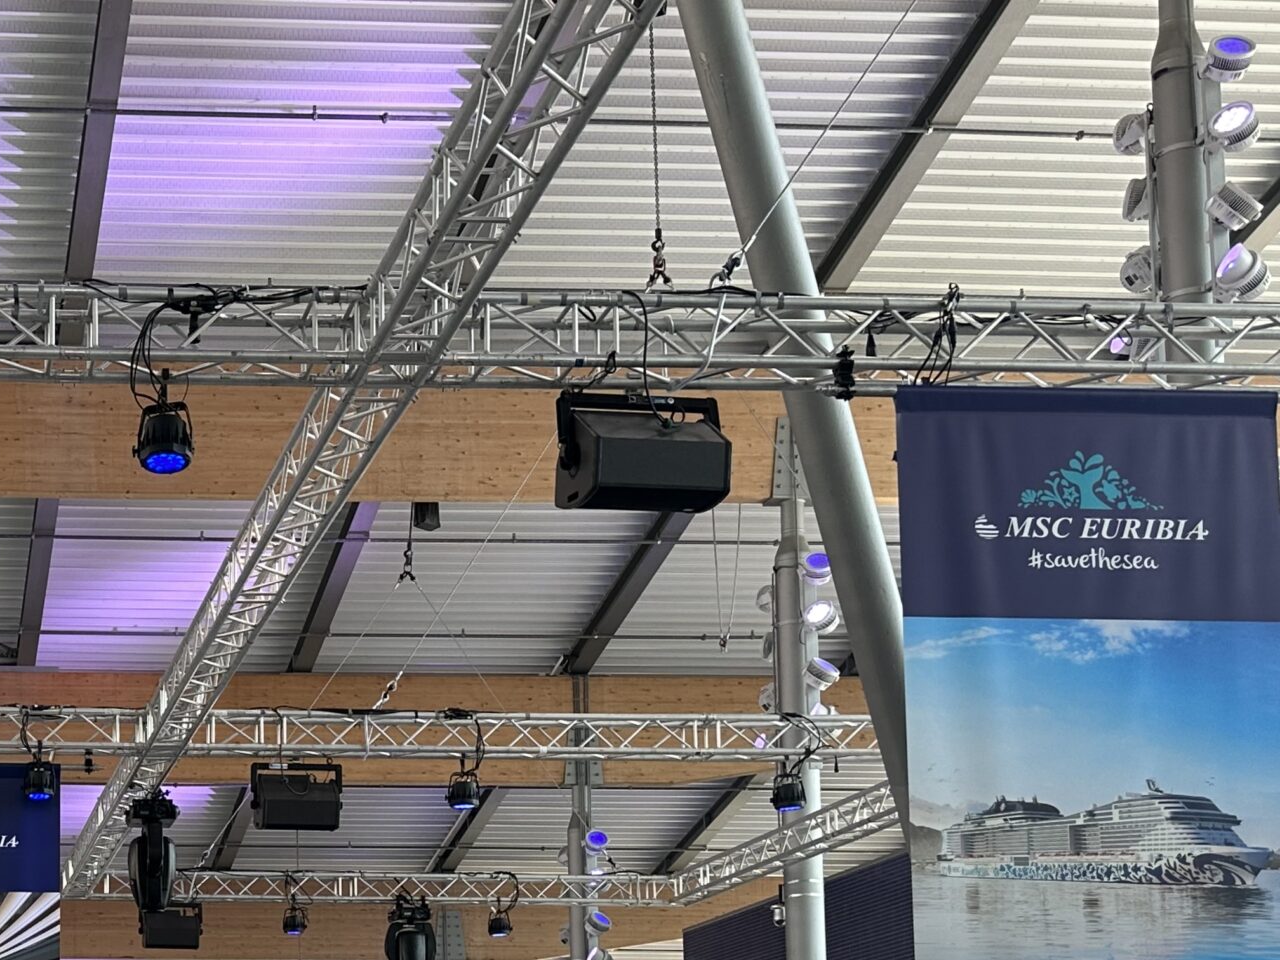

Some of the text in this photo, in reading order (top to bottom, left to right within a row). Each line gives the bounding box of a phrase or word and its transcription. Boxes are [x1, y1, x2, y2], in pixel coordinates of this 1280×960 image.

[1005, 516, 1209, 541] MSC EURIBIA
[1027, 548, 1160, 570] #savethesea
